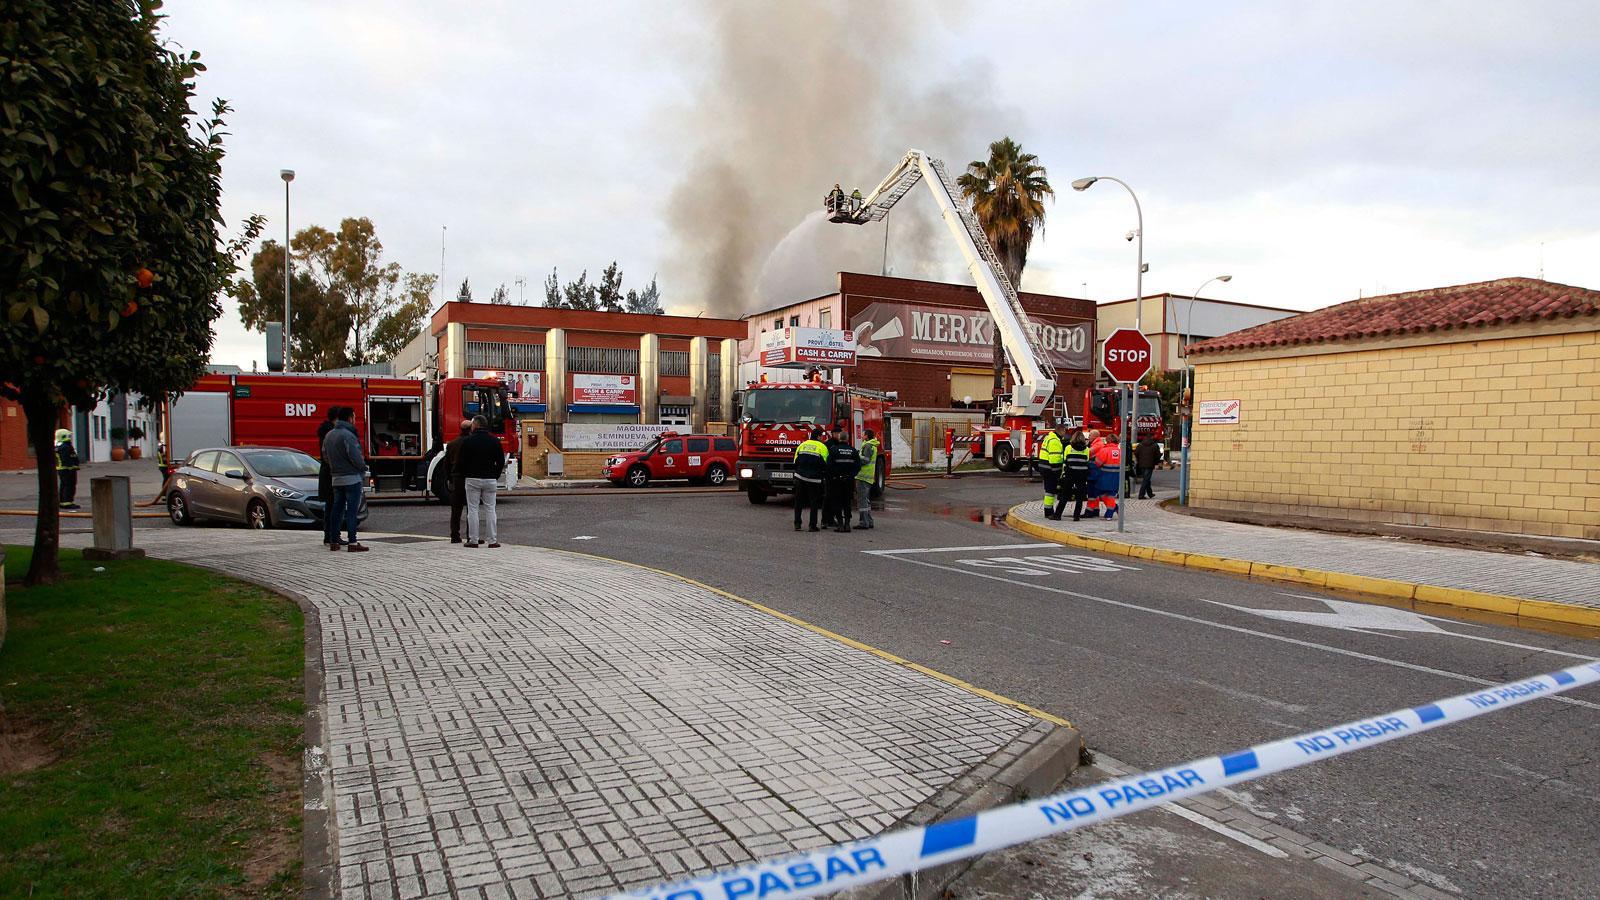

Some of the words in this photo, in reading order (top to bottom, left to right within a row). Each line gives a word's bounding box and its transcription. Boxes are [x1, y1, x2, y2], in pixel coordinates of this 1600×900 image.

[797, 348, 819, 357] CASH
[828, 351, 853, 359] CARRY
[1108, 348, 1148, 363] STOP
[285, 403, 317, 417] BNP
[597, 433, 650, 441] SEMINUEVA,
[955, 554, 1144, 576] STOP
[1466, 693, 1500, 709] NO
[1494, 679, 1551, 701] PASAR
[1295, 735, 1338, 756] NO
[1333, 716, 1410, 746] PASAR
[1039, 796, 1098, 825] NO
[1098, 768, 1207, 810] PASAR
[721, 846, 889, 900] PASAR
